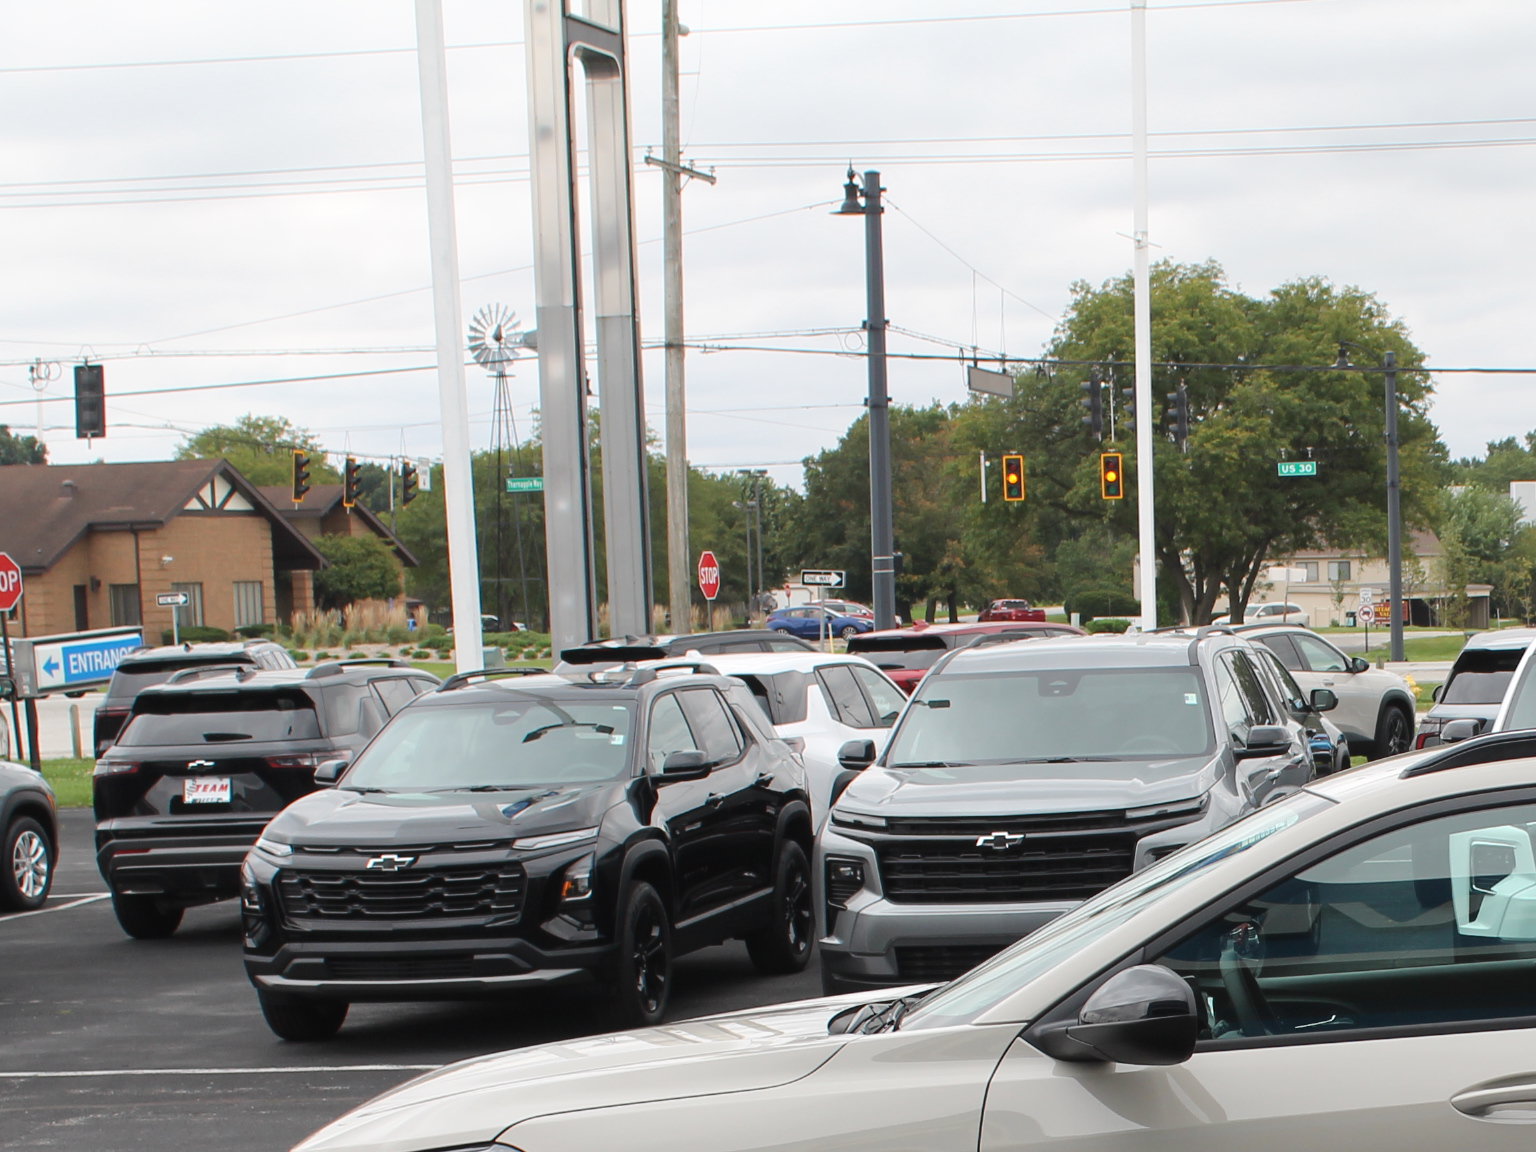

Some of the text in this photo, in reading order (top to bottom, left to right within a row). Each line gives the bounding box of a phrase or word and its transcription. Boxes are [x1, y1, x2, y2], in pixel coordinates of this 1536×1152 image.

[1281, 464, 1313, 474] US 30
[0, 570, 18, 592] OP
[700, 566, 718, 585] STOP
[805, 574, 831, 583] ONE WAY
[69, 645, 136, 675] ENTRAN
[195, 783, 229, 793] TEAM
